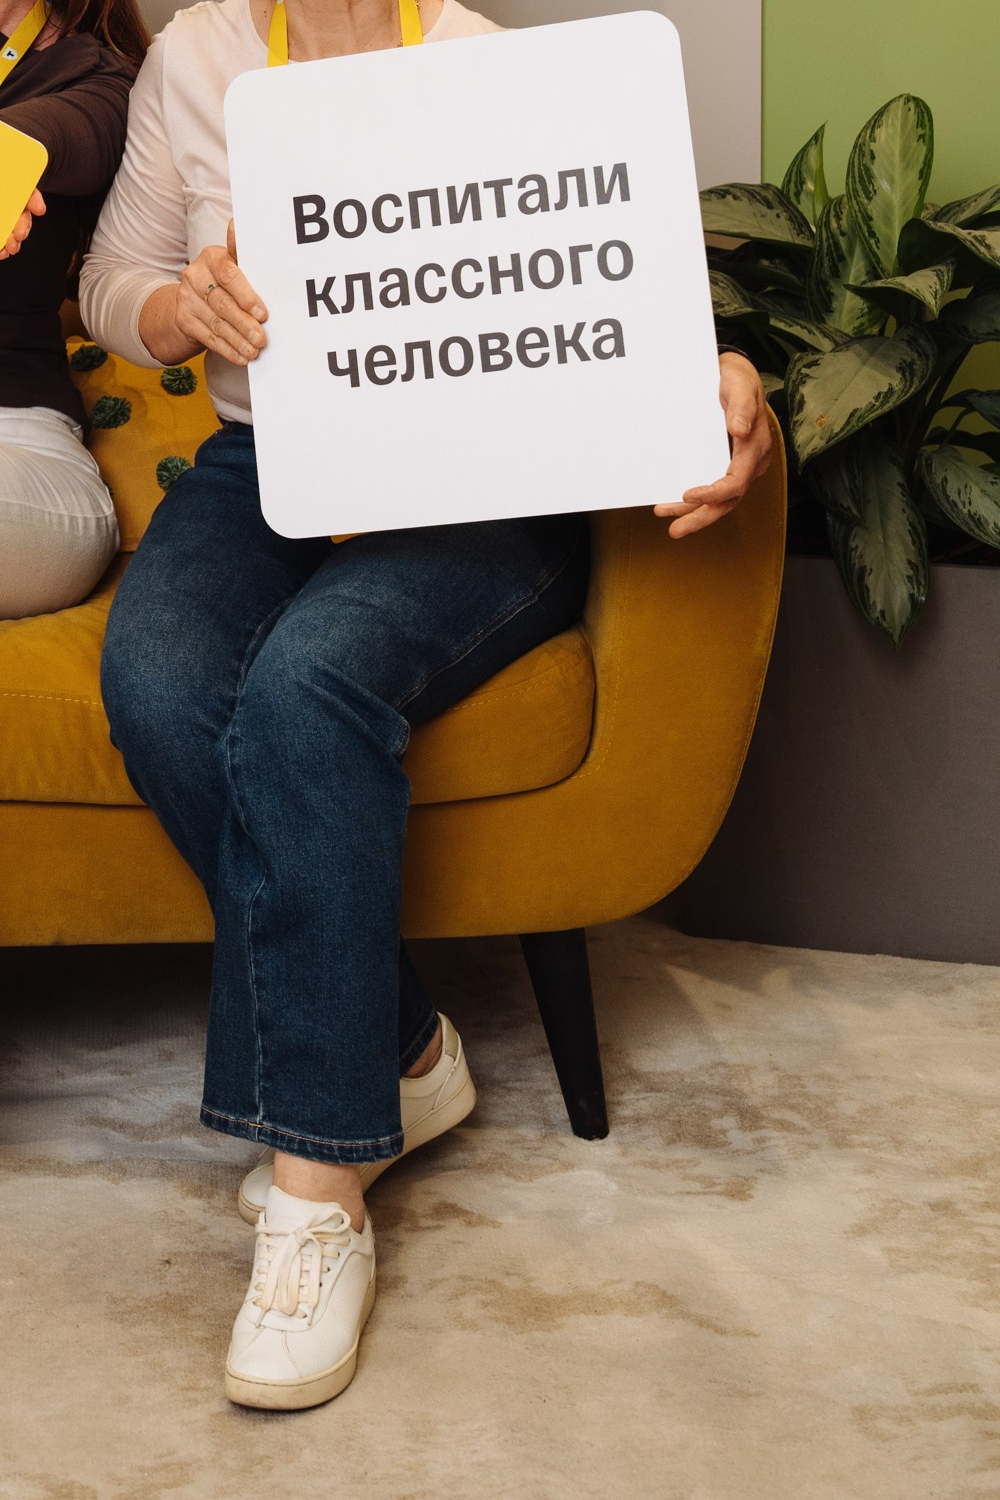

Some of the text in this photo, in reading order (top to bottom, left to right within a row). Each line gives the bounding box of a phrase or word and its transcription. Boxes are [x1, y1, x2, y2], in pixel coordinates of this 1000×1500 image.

[292, 162, 631, 245] Воспитали
[305, 237, 634, 318] классного
[326, 316, 626, 388] человека
